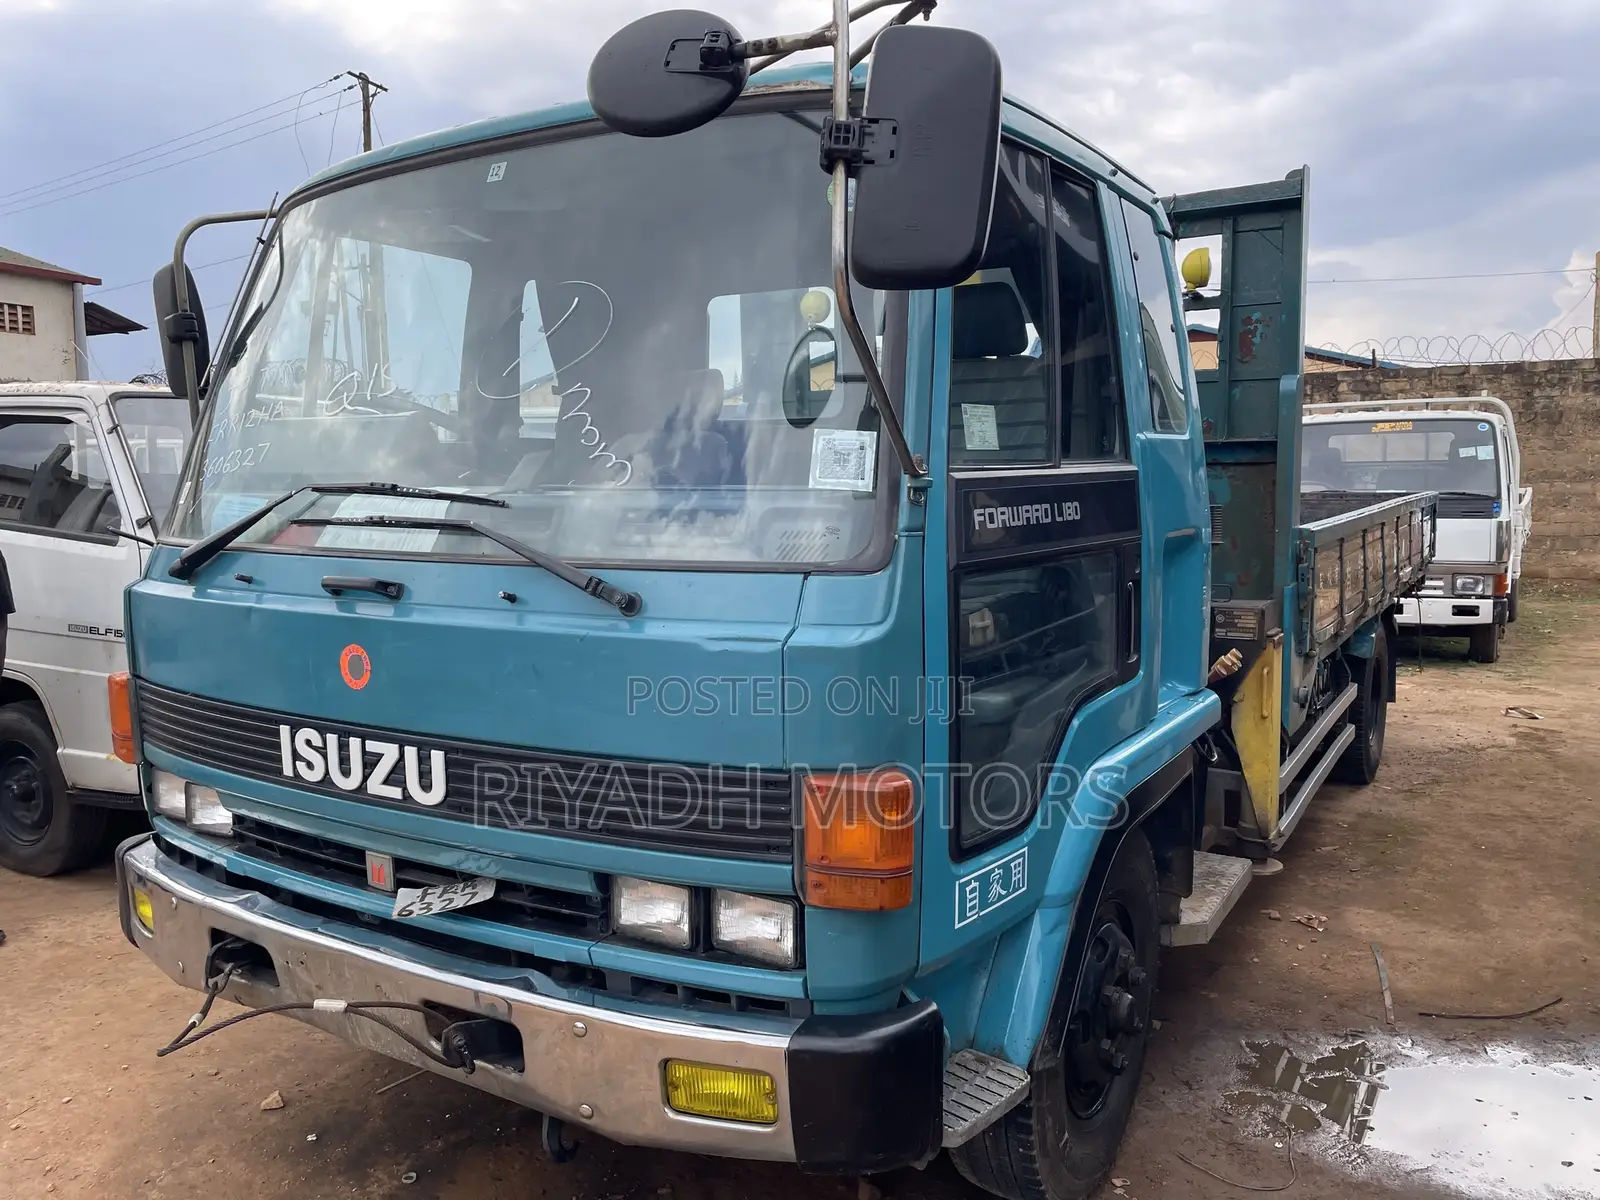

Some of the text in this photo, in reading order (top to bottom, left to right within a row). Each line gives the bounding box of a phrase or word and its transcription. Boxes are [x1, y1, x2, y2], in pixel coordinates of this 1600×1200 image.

[490, 165, 501, 177] 12
[199, 442, 271, 481] 3606327
[973, 503, 1052, 530] FORWARD
[279, 724, 447, 806] ISUZU
[965, 857, 1024, 917] 自家用
[396, 891, 480, 917] 6327
